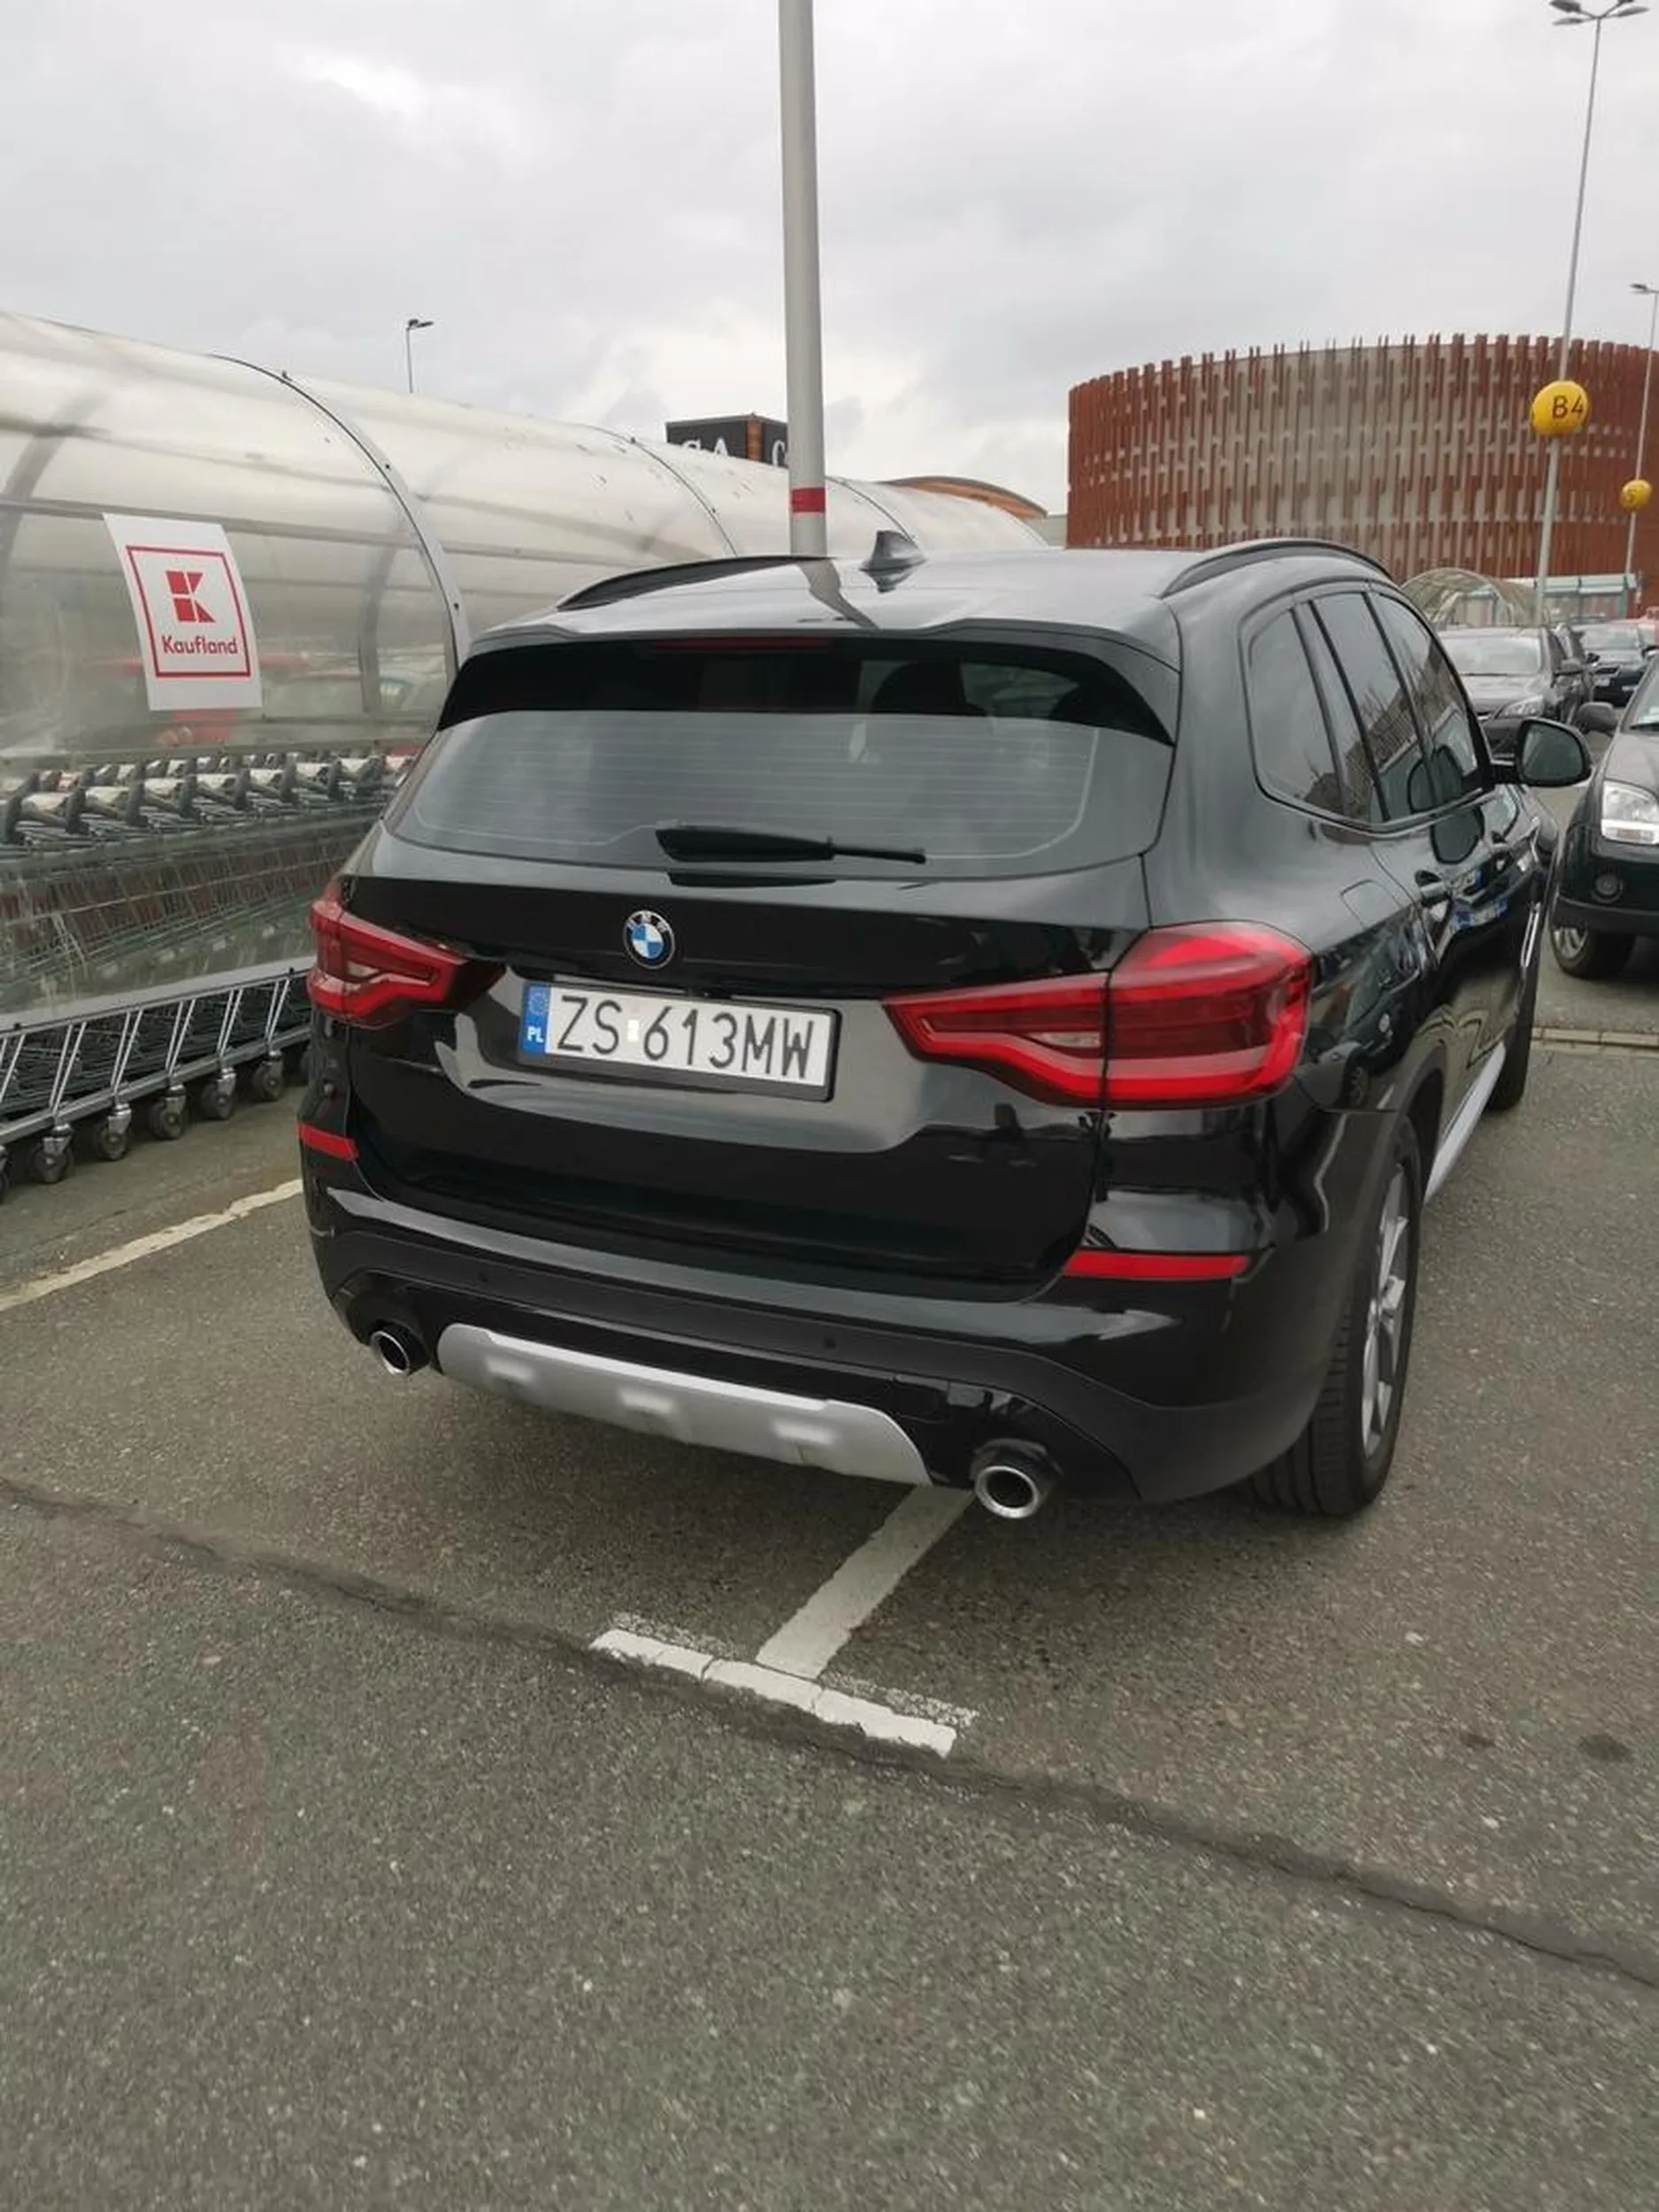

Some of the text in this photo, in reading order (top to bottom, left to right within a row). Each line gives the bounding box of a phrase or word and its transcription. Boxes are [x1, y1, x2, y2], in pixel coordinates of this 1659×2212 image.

[1552, 395, 1583, 419] B4
[161, 634, 238, 655] Kaufland
[526, 1025, 545, 1044] PL
